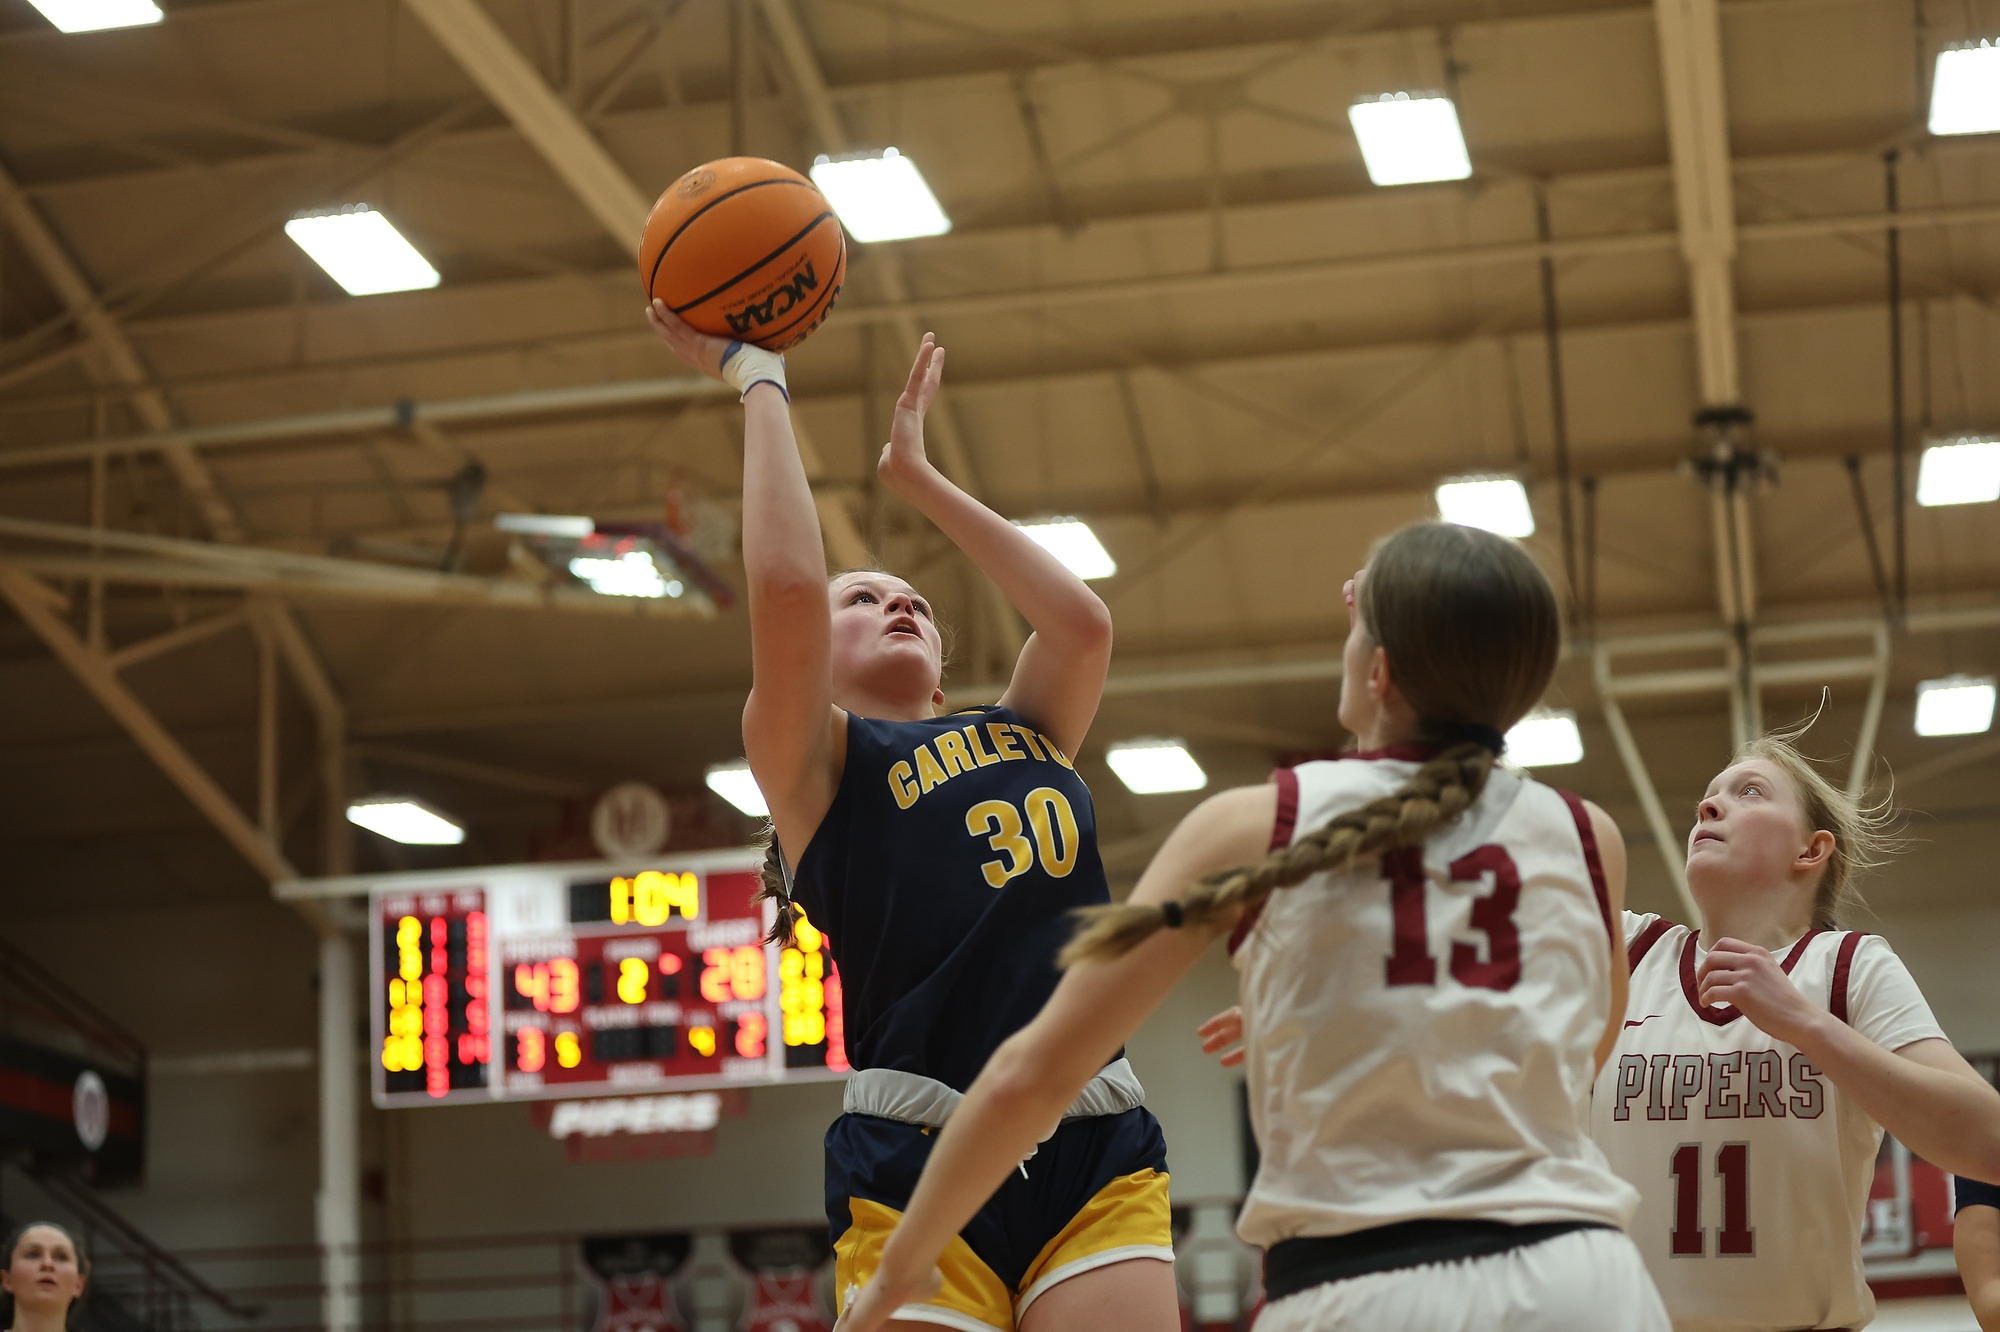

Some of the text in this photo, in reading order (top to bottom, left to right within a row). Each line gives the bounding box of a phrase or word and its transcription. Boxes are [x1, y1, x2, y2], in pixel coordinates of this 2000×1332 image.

[725, 260, 818, 334] NCAA
[887, 722, 1080, 810] CARLETO
[965, 787, 1079, 889] 30
[610, 870, 698, 926] 1:04
[1379, 844, 1523, 993] 13
[515, 957, 580, 1014] 43
[616, 957, 649, 1005] 2
[701, 944, 768, 1003] 28
[1613, 1050, 1826, 1123] PIPERS
[1668, 1140, 1757, 1259] 11
